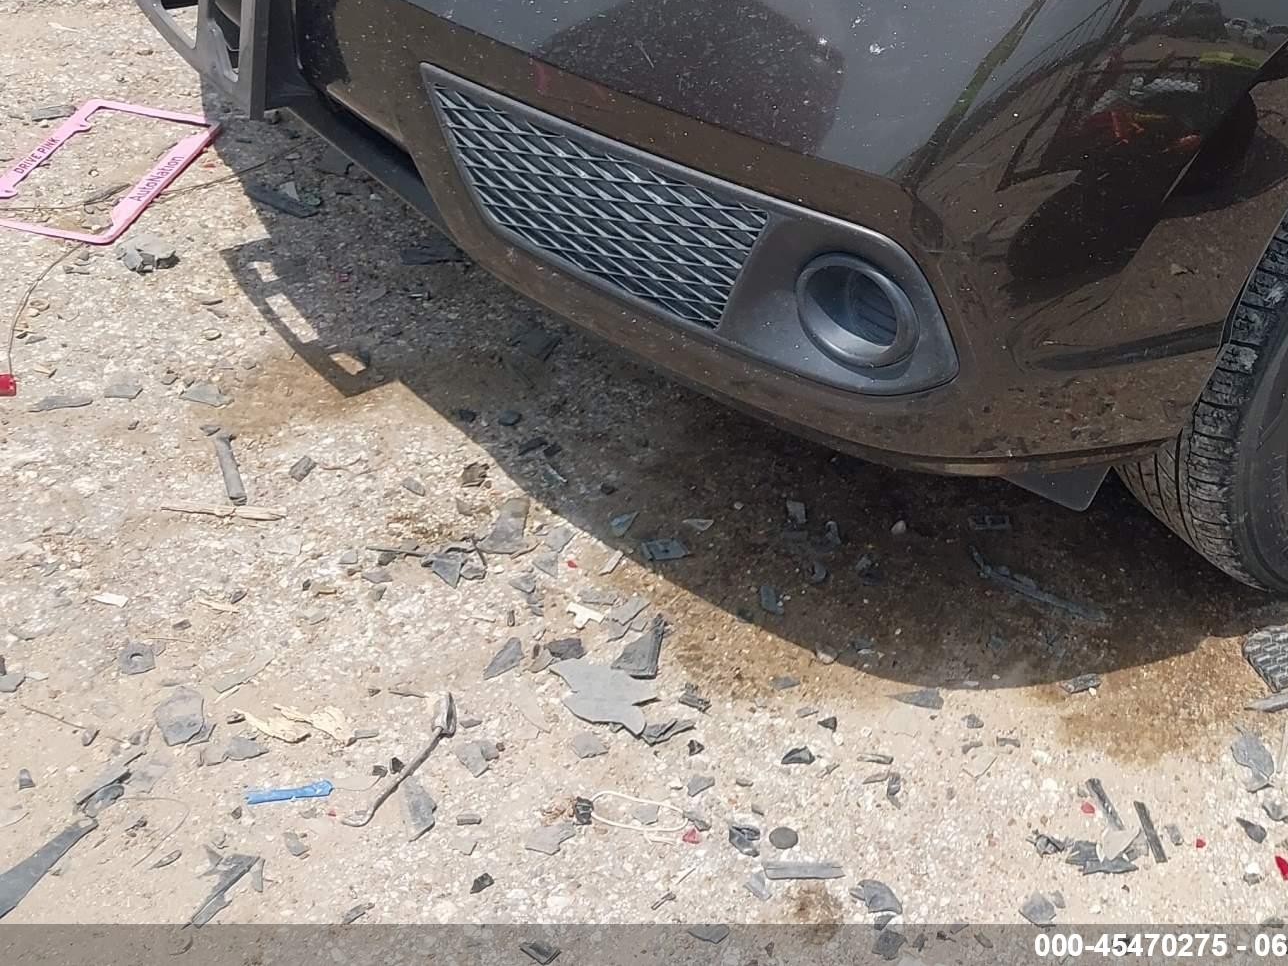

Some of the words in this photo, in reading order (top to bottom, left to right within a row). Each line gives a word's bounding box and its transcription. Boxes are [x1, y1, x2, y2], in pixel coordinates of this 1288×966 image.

[13, 152, 42, 174] DRIVE
[37, 137, 60, 154] PINK
[128, 156, 185, 202] AutoNation
